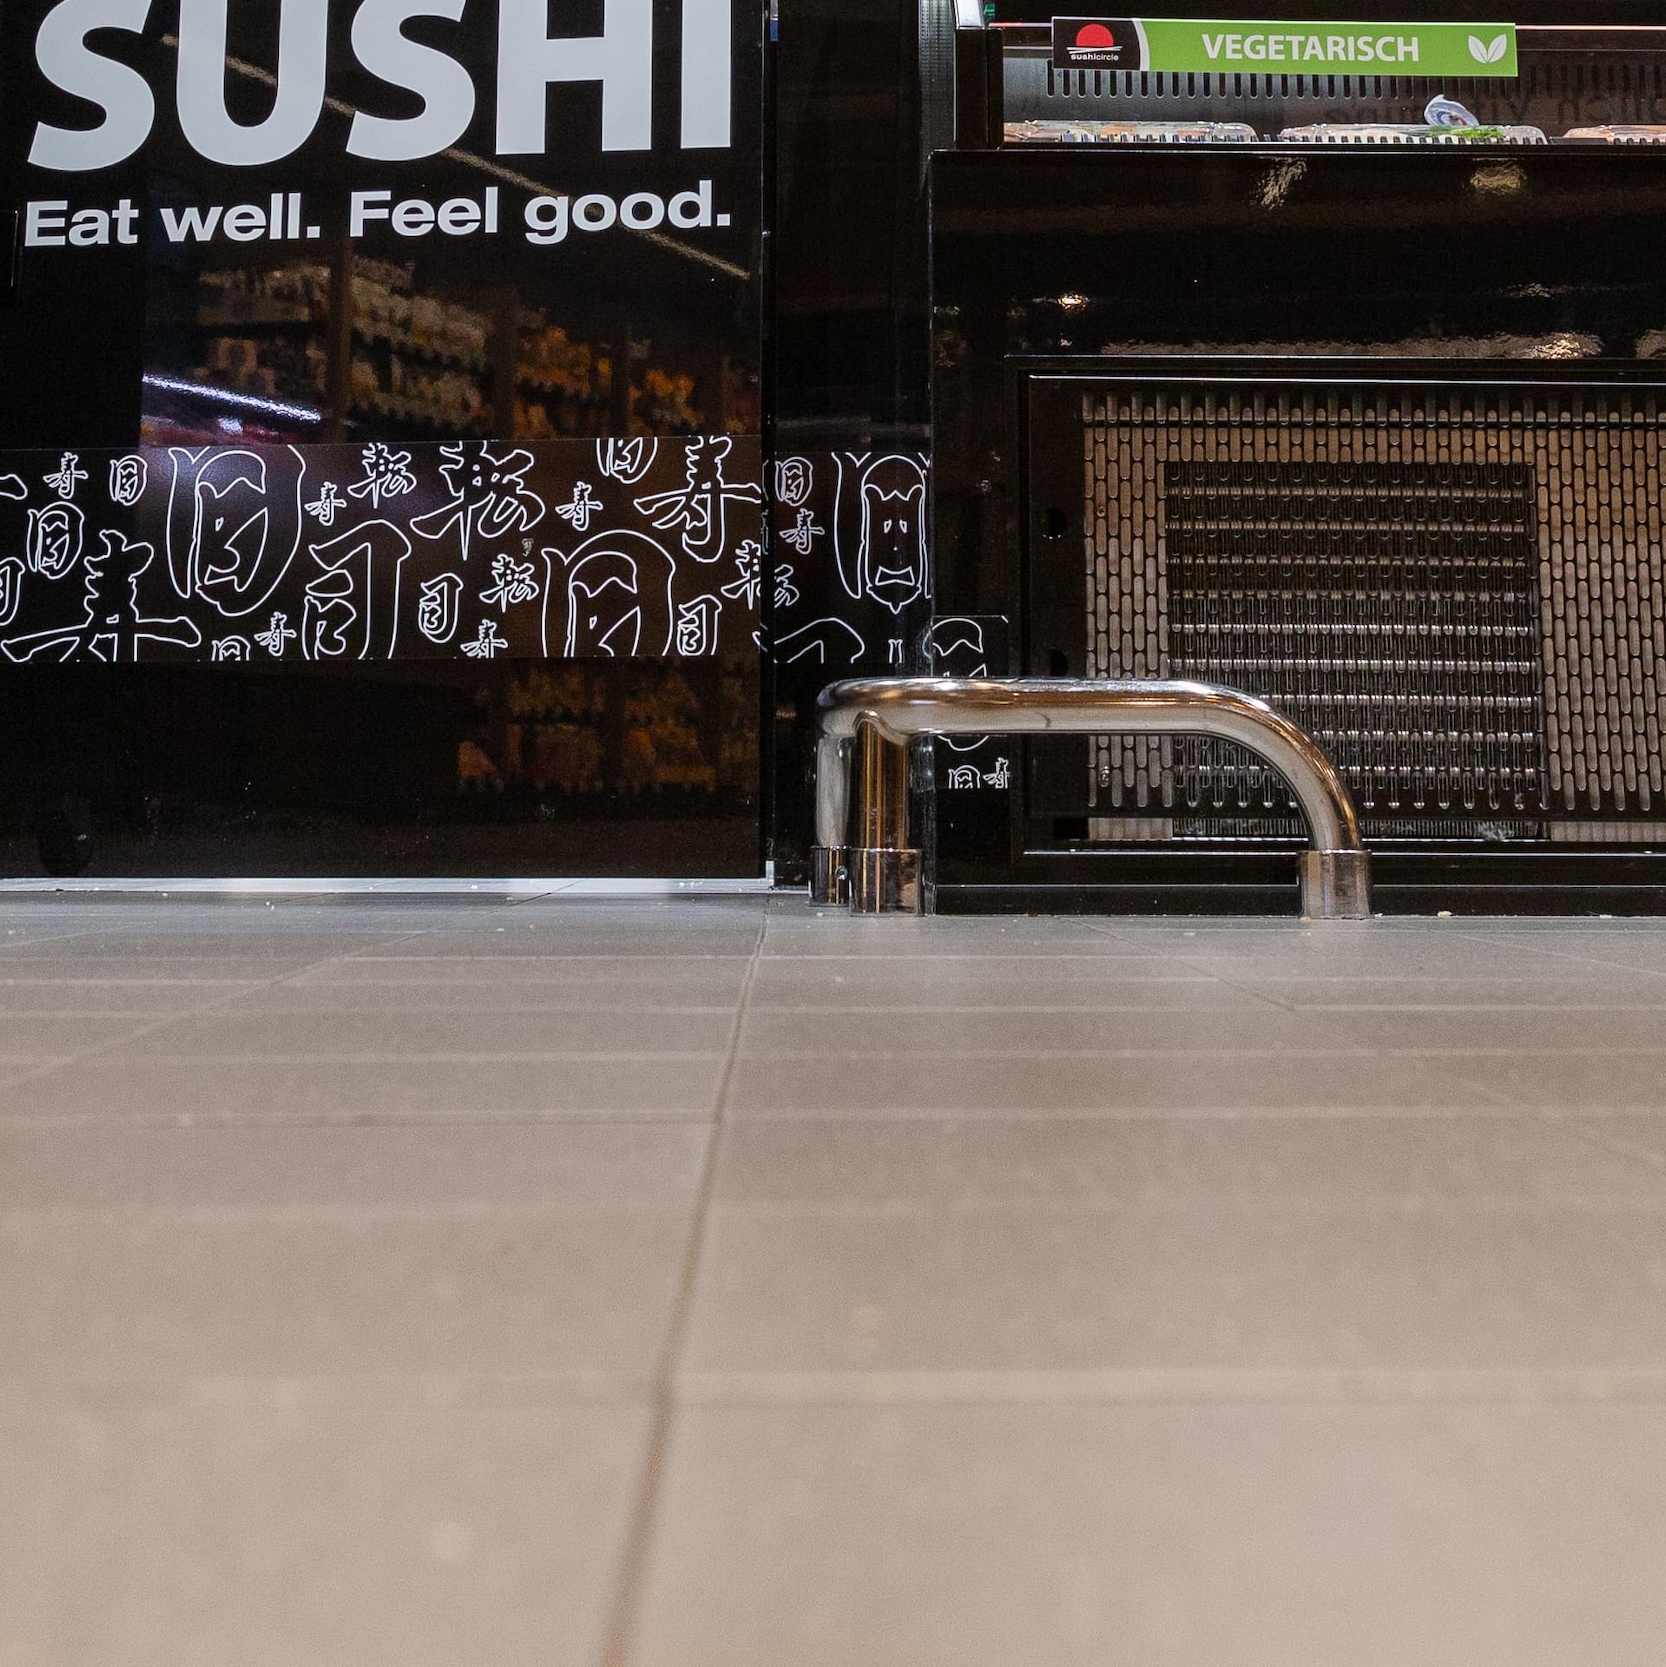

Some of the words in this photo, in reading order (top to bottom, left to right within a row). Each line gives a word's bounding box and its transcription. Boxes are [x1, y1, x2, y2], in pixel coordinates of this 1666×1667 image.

[1201, 33, 1420, 63] VEGETARISCH
[24, 199, 139, 247] Eat
[161, 192, 321, 243] well.
[349, 186, 499, 239] Feel
[524, 179, 732, 246] good.
